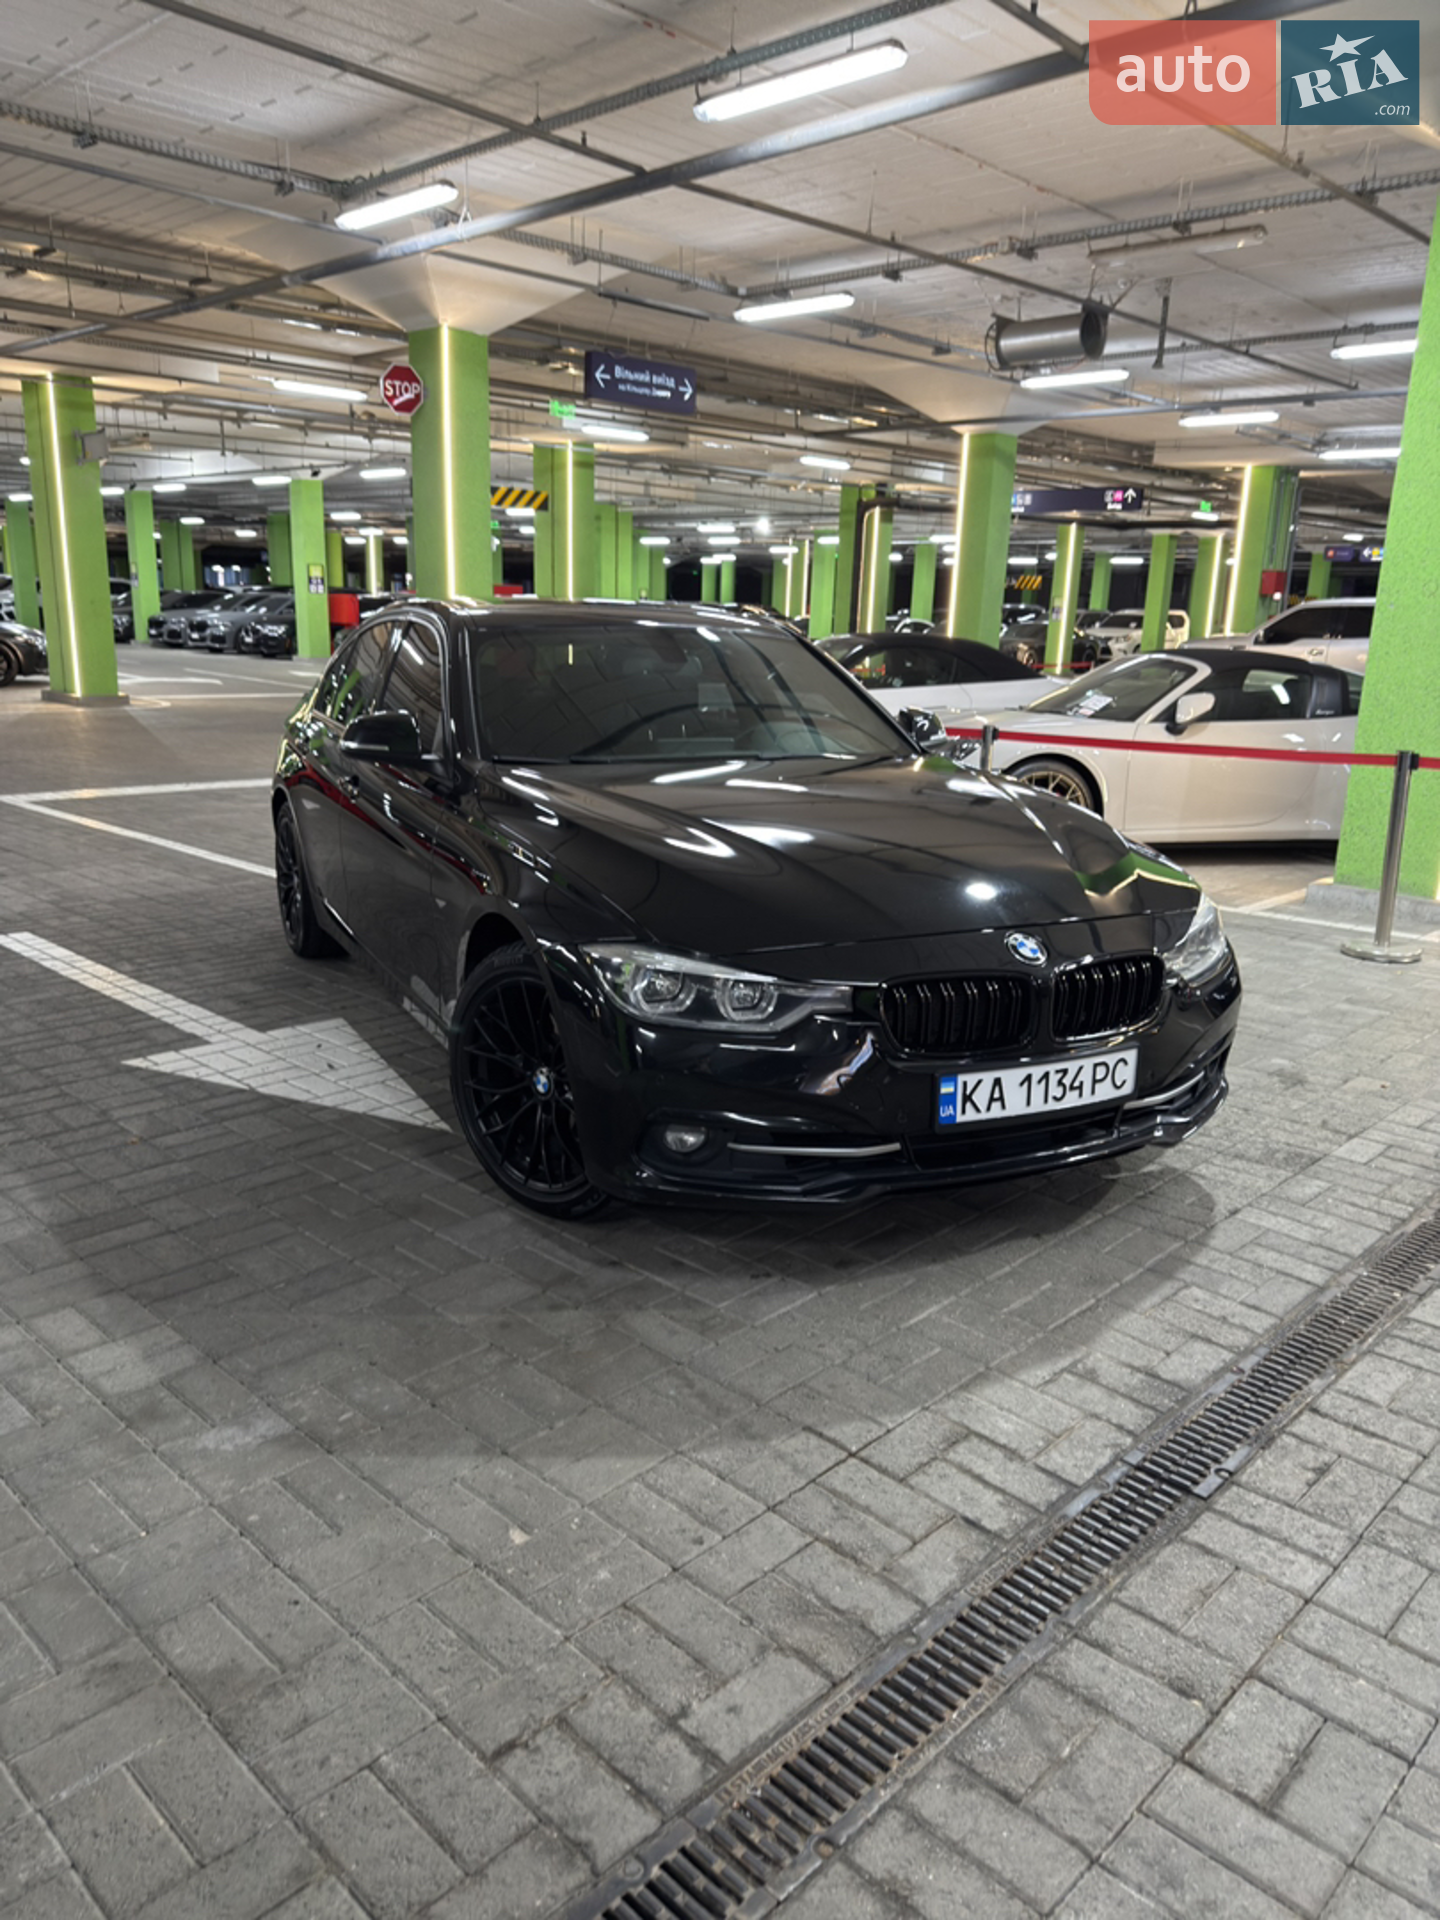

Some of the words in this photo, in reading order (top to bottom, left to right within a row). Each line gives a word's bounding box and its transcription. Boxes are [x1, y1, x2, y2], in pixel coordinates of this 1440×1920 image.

[385, 379, 421, 397] STOP
[961, 1077, 1006, 1116] KA
[1019, 1065, 1084, 1108] 1134
[1091, 1057, 1129, 1096] PC
[940, 1105, 955, 1117] UA
